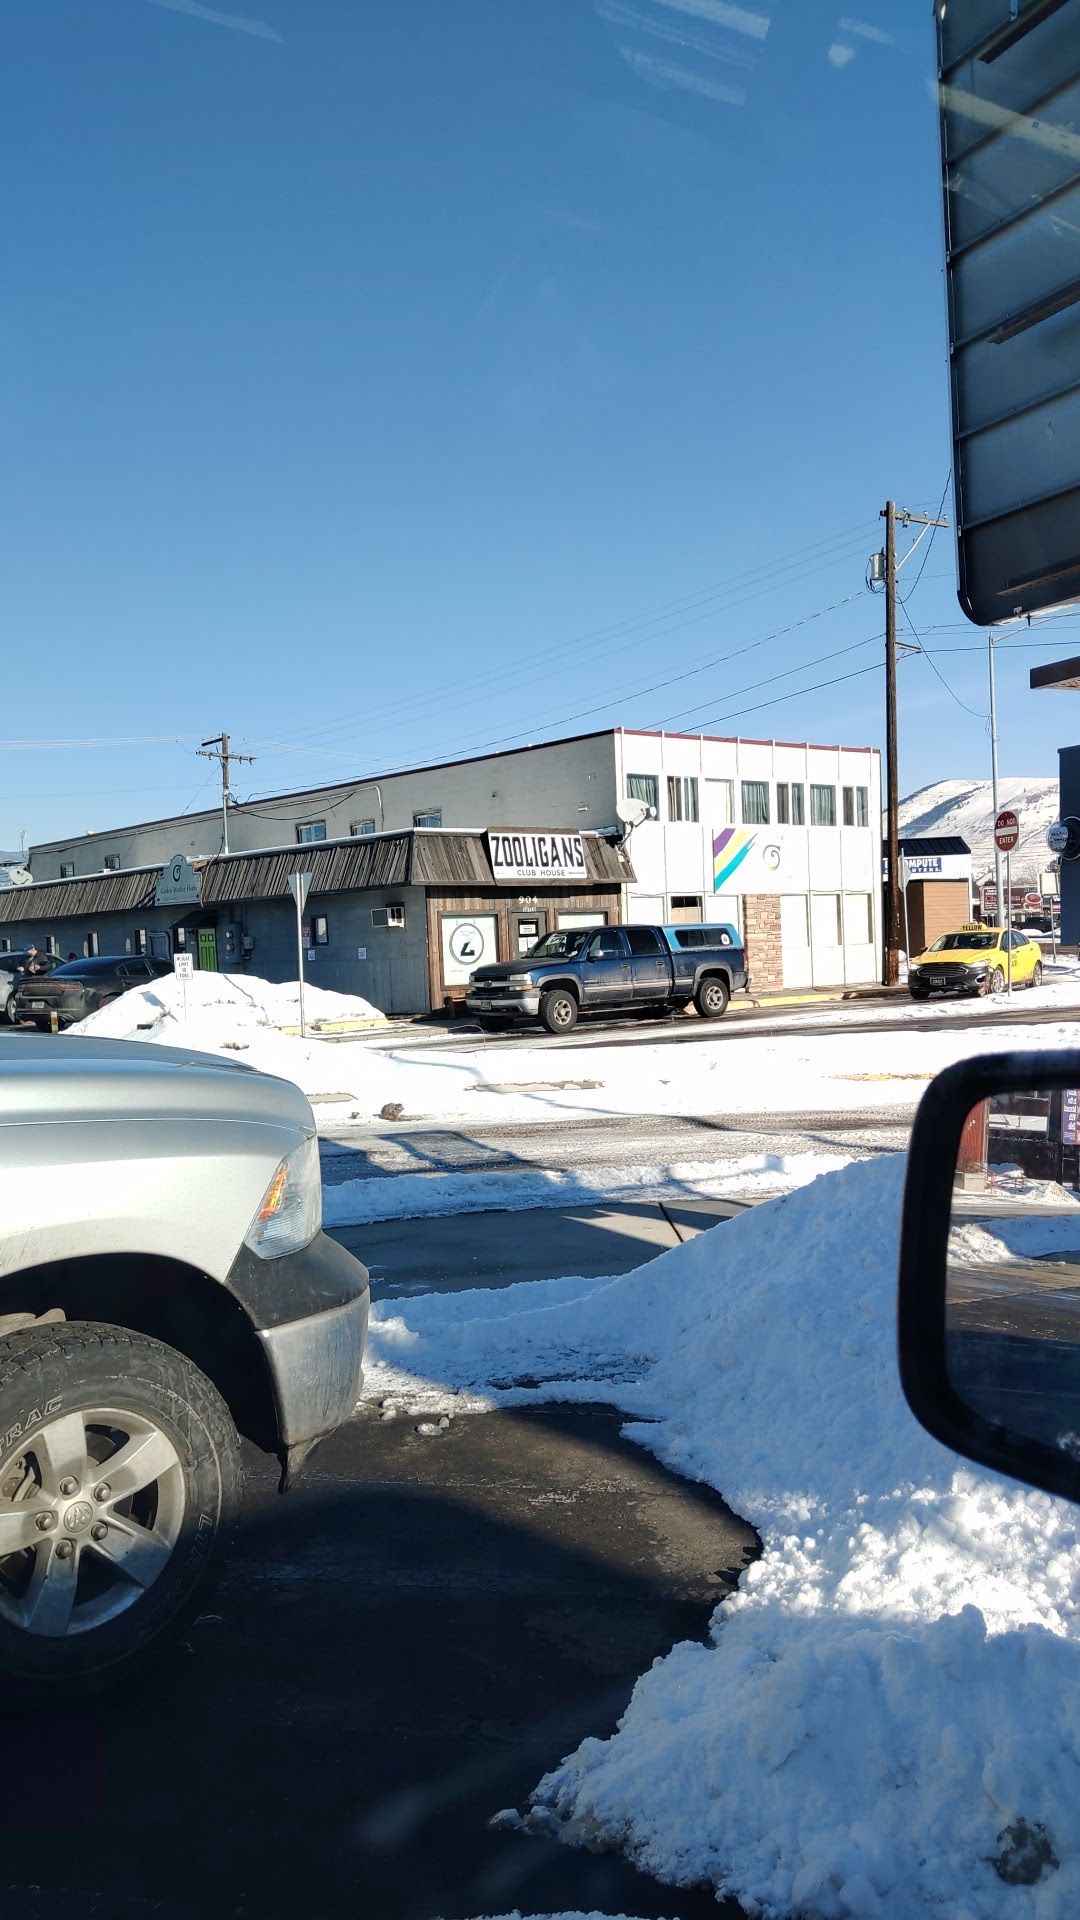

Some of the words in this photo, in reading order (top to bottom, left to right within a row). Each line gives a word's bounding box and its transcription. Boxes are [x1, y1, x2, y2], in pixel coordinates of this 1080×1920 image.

[999, 836, 1014, 844] ENTER
[491, 836, 584, 867] ZOOLIGANS
[518, 896, 538, 904] 904
